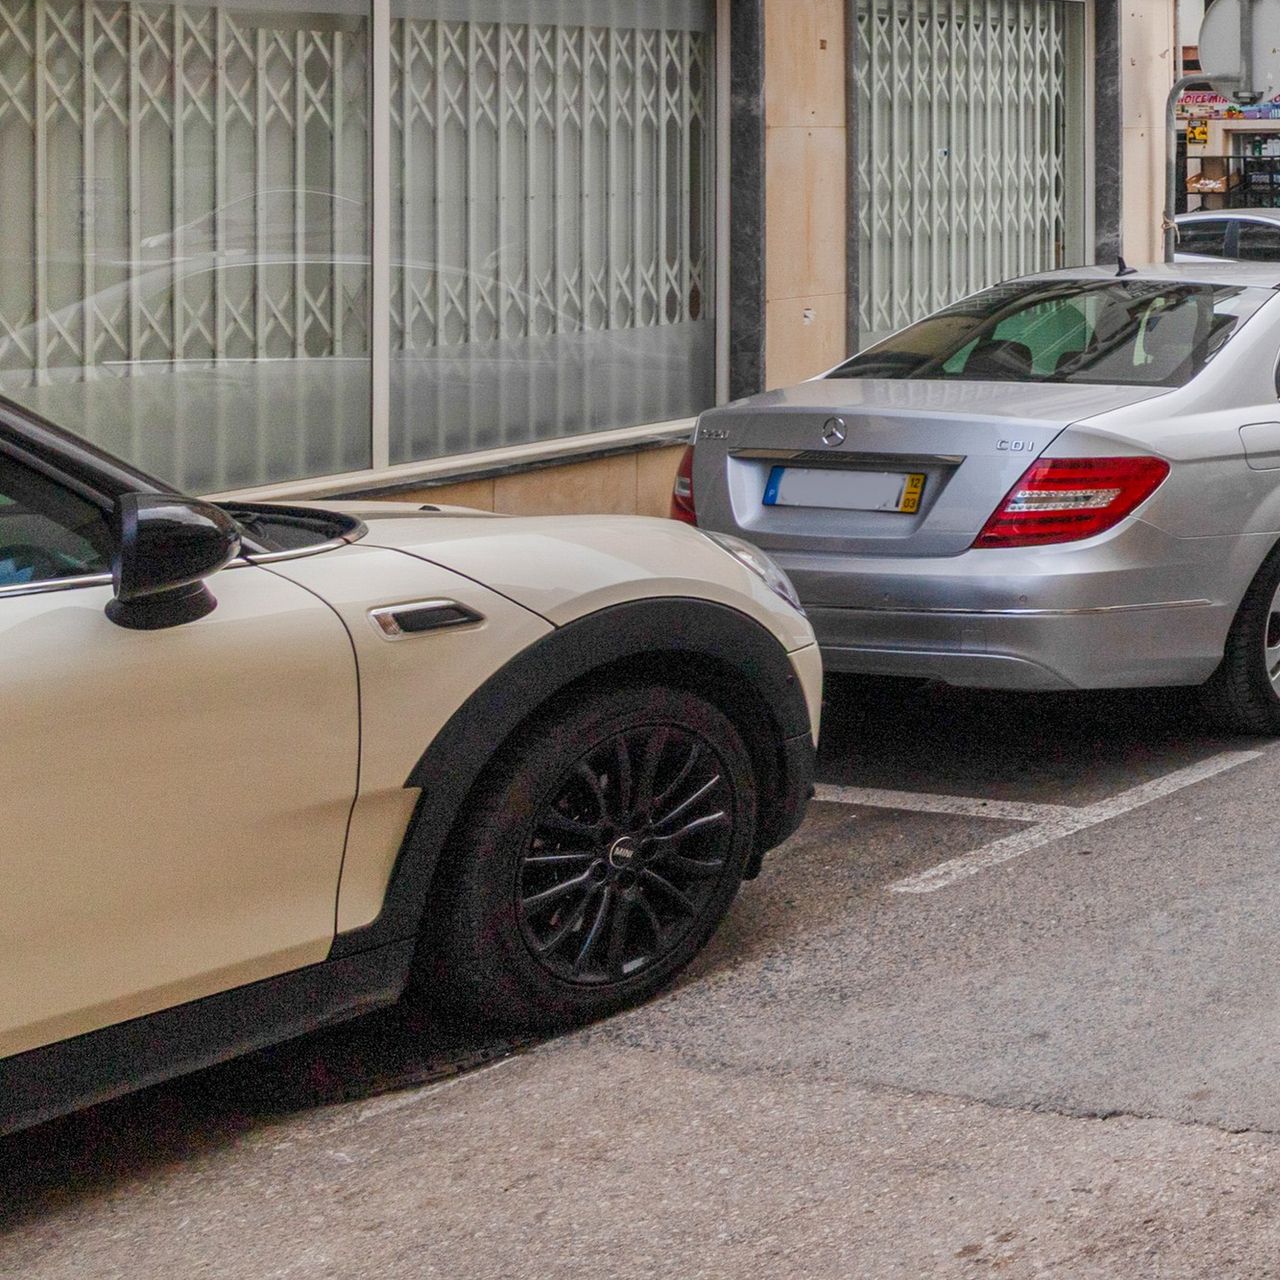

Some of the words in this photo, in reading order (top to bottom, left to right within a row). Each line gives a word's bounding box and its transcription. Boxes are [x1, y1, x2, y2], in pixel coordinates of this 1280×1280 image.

[996, 439, 1034, 452] CDI
[910, 477, 921, 488] 12
[903, 497, 917, 509] 03
